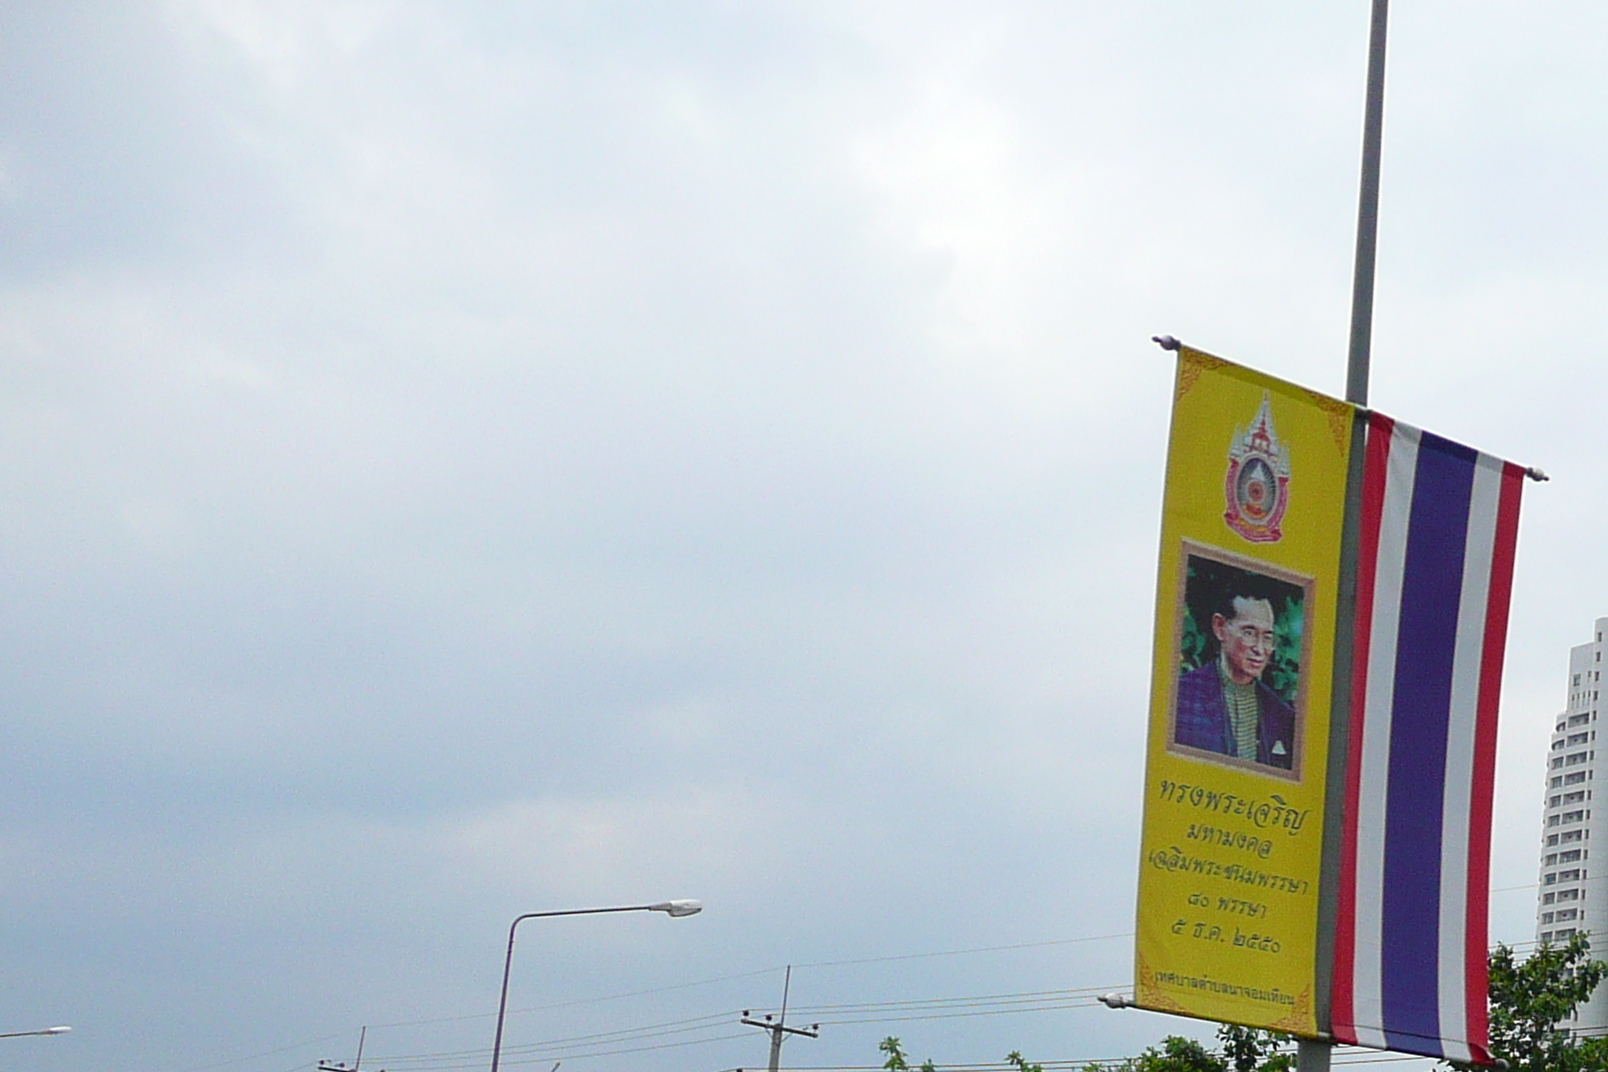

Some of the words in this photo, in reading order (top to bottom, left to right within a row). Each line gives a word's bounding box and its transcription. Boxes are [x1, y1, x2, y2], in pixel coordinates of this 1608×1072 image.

[1160, 779, 1311, 836] ทรงพระเจริญ
[1186, 823, 1273, 859] มหามงคล
[1148, 845, 1310, 896] เฉลิมพระชนมพรรษา
[1187, 893, 1210, 908] ๘๐
[1217, 896, 1267, 919] พรรษา
[1171, 918, 1187, 935] ๕
[1193, 922, 1226, 943] ธ.ค.
[1233, 926, 1281, 954] ๒๕๕๐
